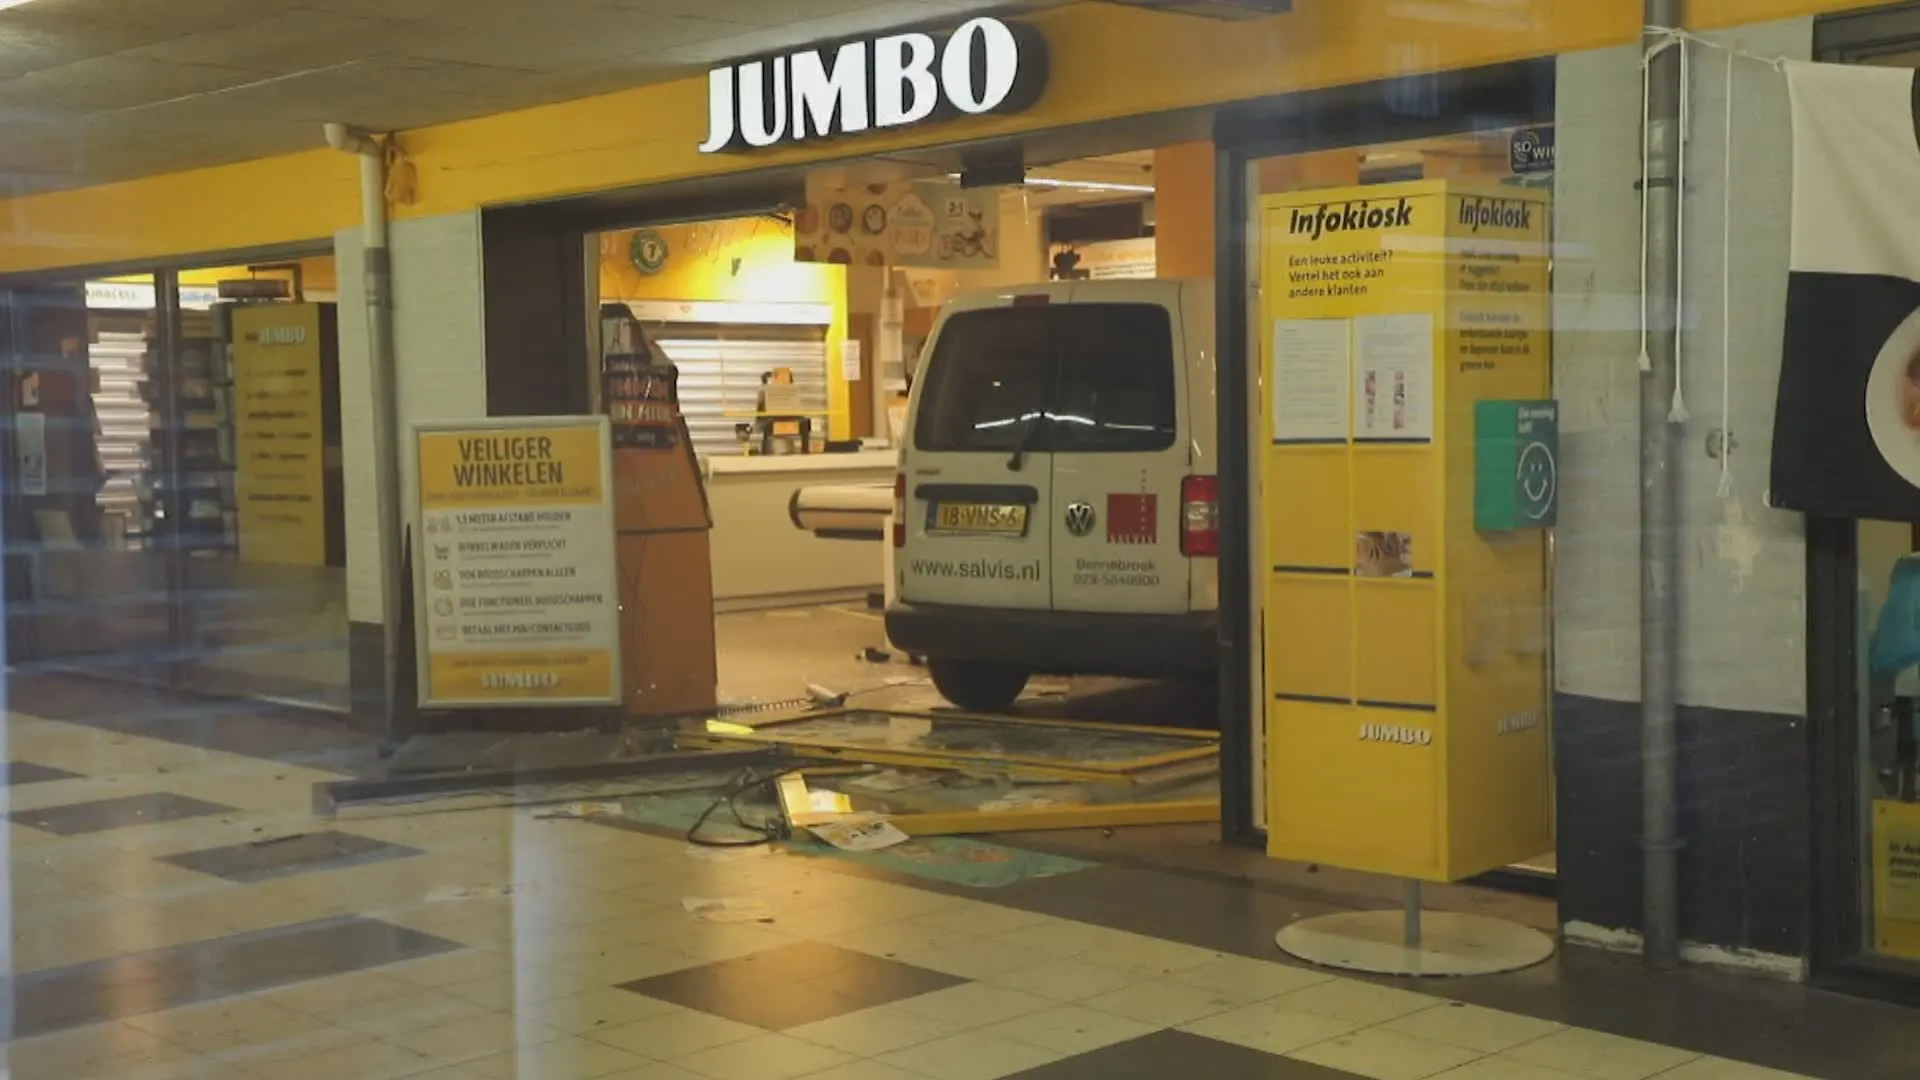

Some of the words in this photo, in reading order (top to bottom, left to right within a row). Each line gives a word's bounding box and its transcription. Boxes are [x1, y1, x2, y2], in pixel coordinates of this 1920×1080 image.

[698, 16, 1018, 153] JUMBO
[1289, 198, 1412, 241] Infokiosk
[1459, 197, 1530, 232] Infokiosk
[1289, 255, 1308, 266] Een
[1310, 254, 1338, 266] leuke
[1340, 249, 1393, 264] activiteit?
[1289, 270, 1320, 282] Vertel
[1322, 269, 1340, 281] het
[1341, 268, 1361, 280] ook
[1364, 268, 1384, 278] aan
[1289, 287, 1325, 298] andere
[1327, 283, 1367, 296] klanten
[260, 326, 306, 345] JUMBO
[457, 436, 552, 462] VEILIGER
[453, 461, 564, 487] WINKELEN
[942, 506, 1018, 526] 18-VNS-6
[911, 559, 1040, 581] www.salvis.nl
[1358, 722, 1432, 746] JUMBO
